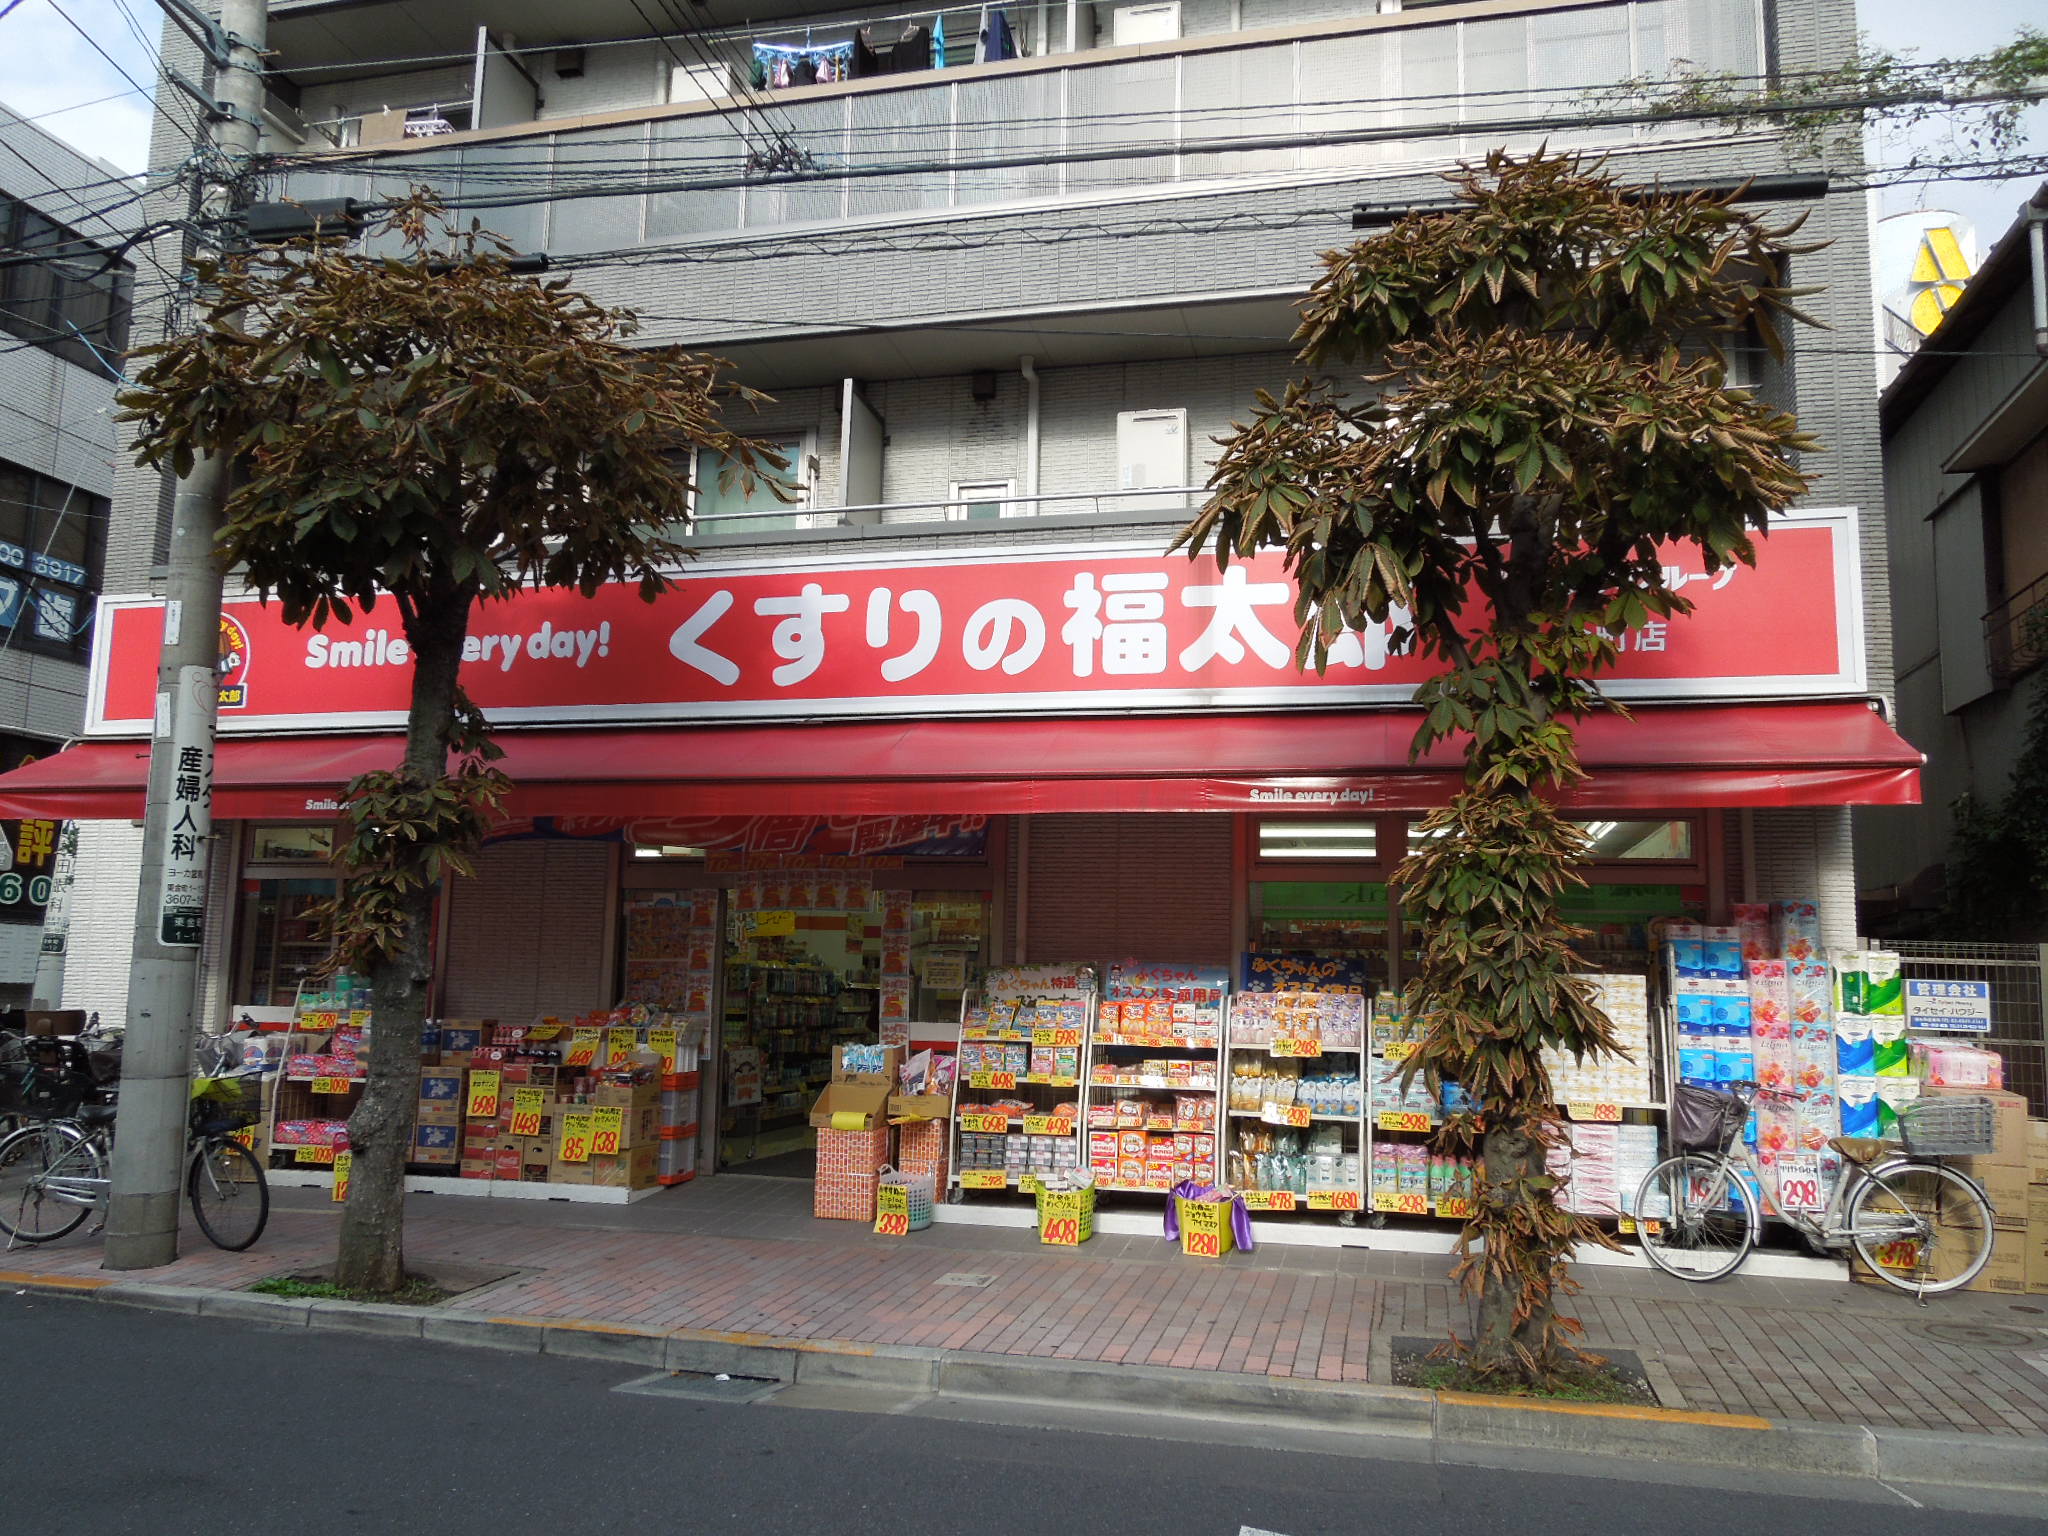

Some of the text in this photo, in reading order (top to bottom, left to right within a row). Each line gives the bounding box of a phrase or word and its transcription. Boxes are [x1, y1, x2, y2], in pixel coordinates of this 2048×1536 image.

[305, 628, 410, 668] Smile
[527, 621, 611, 668] day!
[170, 746, 203, 862] 産婦人科
[306, 799, 338, 810] Smile
[1250, 788, 1374, 805] Smile every day!
[1917, 982, 1977, 997] 管理会社
[1056, 1030, 1077, 1045] 598
[991, 1072, 1014, 1088] 498
[512, 1112, 539, 1135] 148
[982, 1115, 1007, 1131] 698
[1287, 1107, 1309, 1125] 298
[1401, 1113, 1429, 1131] 298
[1046, 1118, 1069, 1134] 498
[564, 1137, 585, 1160] 85
[1269, 1192, 1292, 1209] 478
[1783, 1179, 1817, 1205] 298
[1398, 1194, 1427, 1213] 298
[878, 1212, 907, 1234] 398
[1044, 1217, 1077, 1244] 498
[1187, 1231, 1218, 1257] 1280
